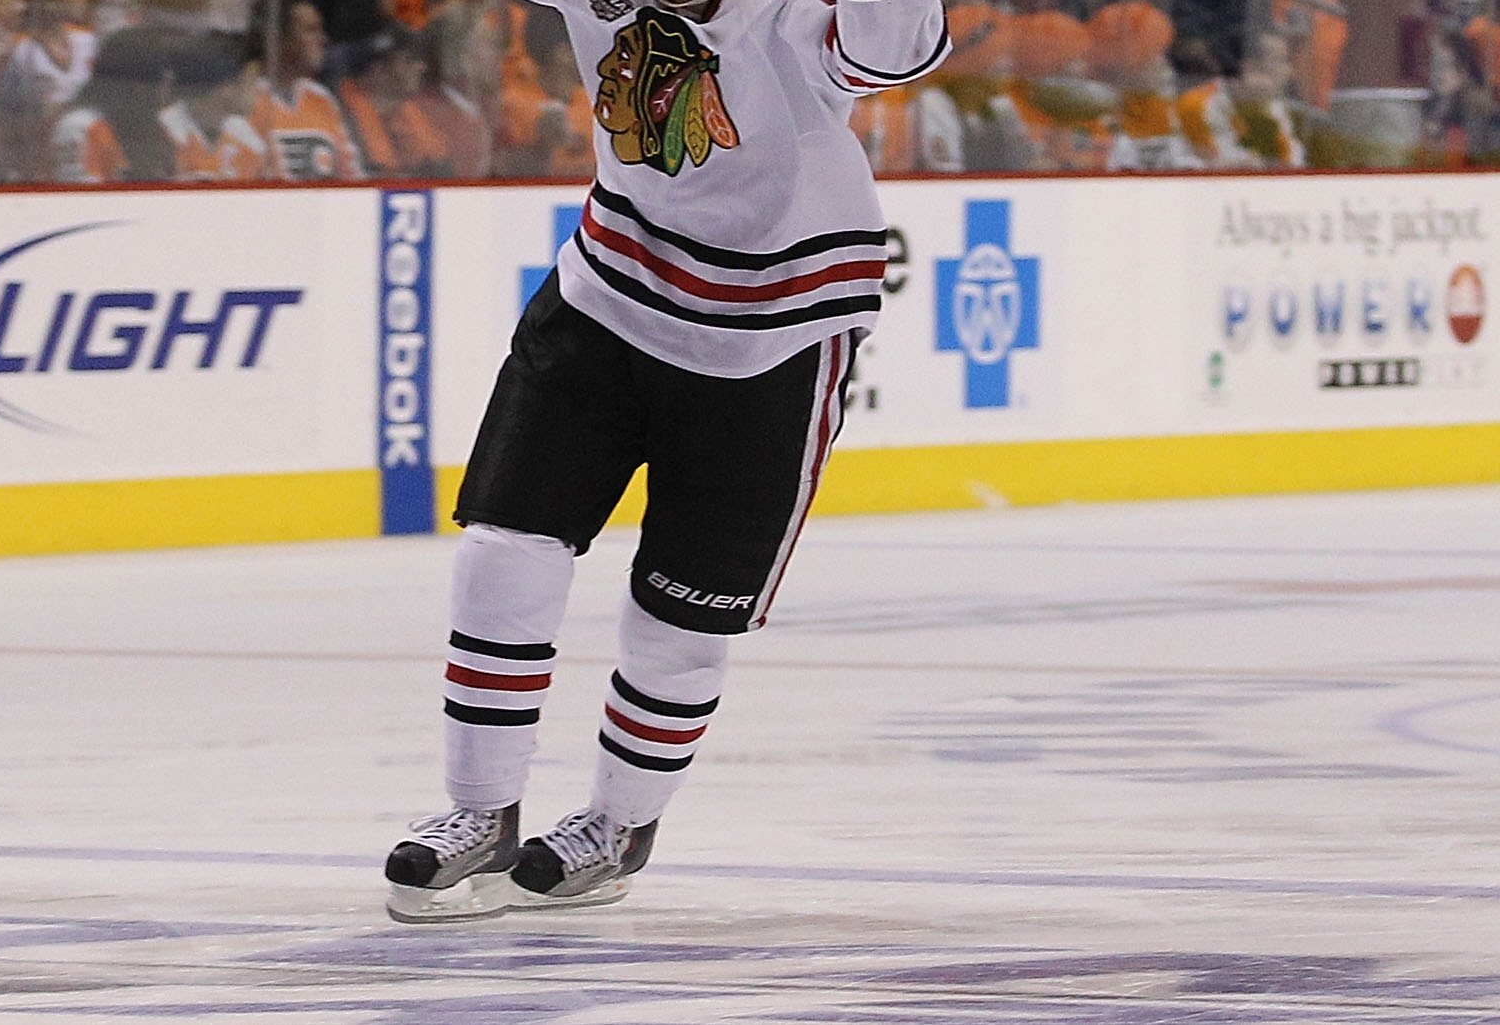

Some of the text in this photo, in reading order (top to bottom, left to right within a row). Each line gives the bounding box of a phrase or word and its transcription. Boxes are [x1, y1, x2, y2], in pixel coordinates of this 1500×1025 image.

[1218, 201, 1309, 257] Always
[1320, 211, 1333, 243] a
[1343, 197, 1379, 255] big
[385, 192, 426, 467] Reebok
[1223, 279, 1434, 339] POWER
